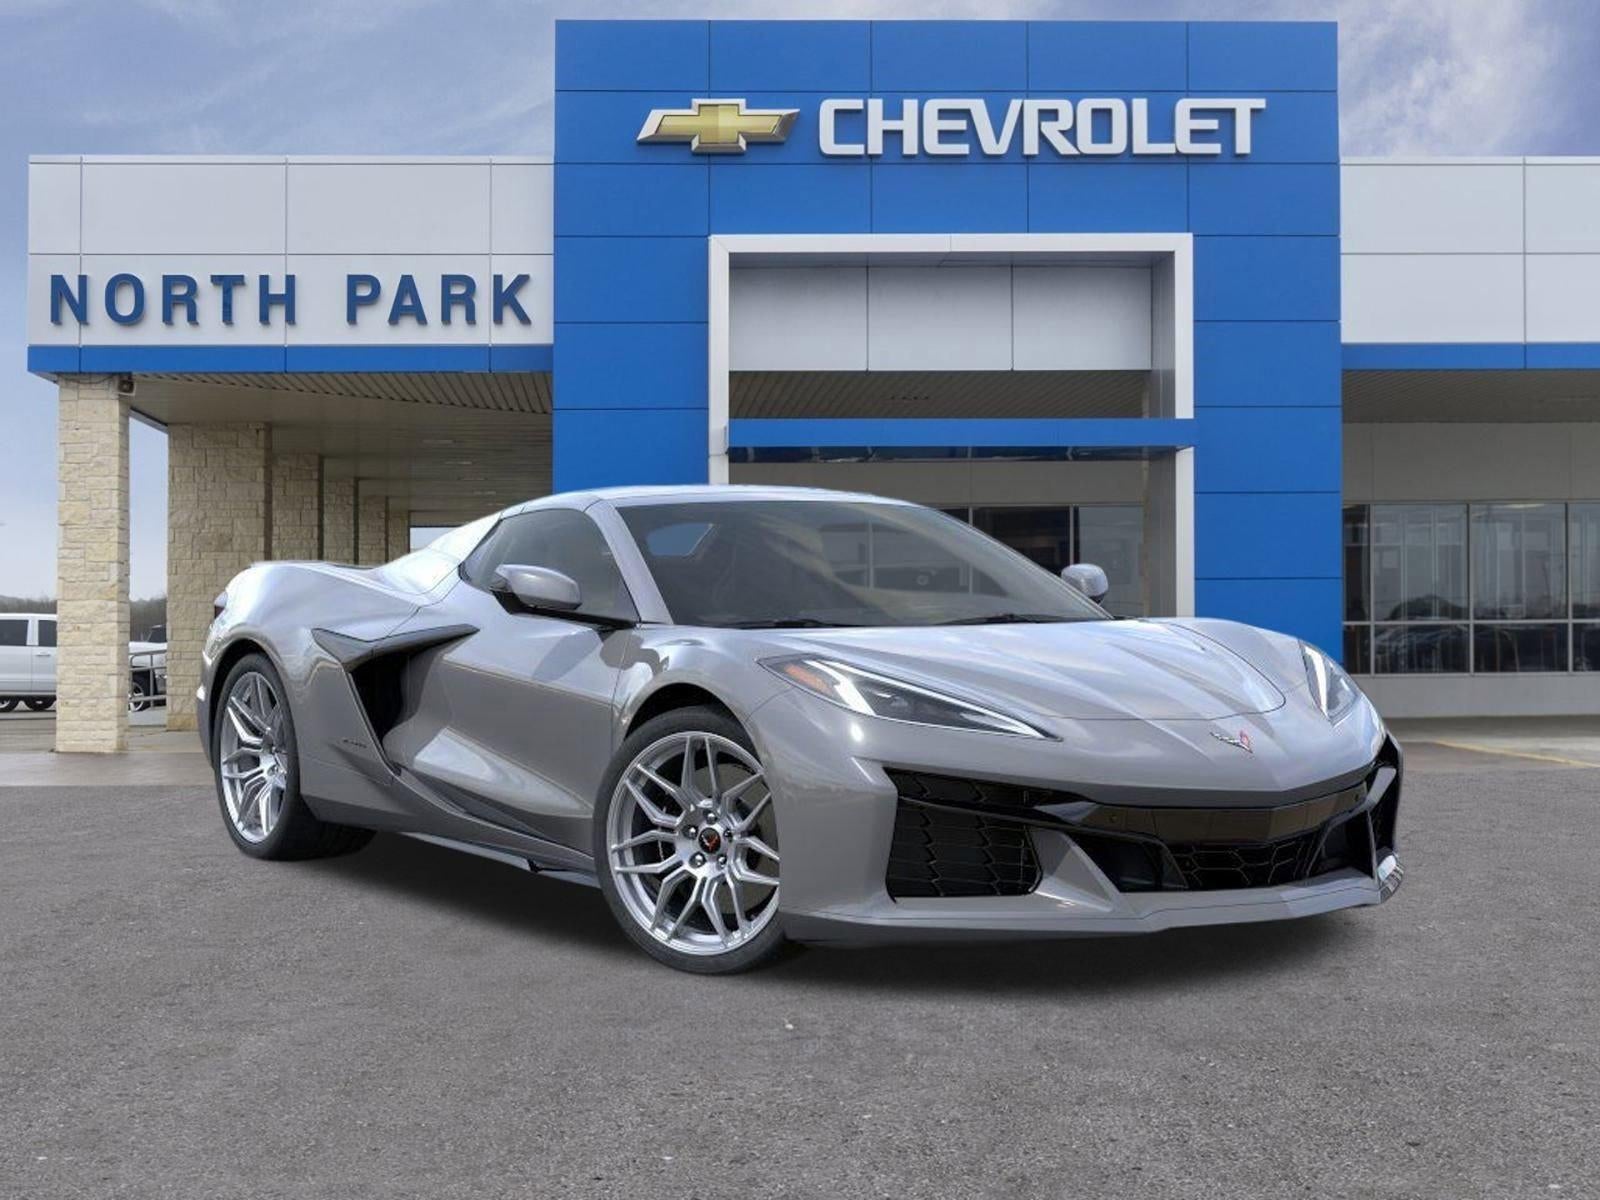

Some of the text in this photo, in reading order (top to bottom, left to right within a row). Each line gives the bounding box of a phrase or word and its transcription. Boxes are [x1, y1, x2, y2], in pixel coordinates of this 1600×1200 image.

[819, 97, 1267, 157] CHEVROLET
[50, 273, 533, 325] NORTH PARK
